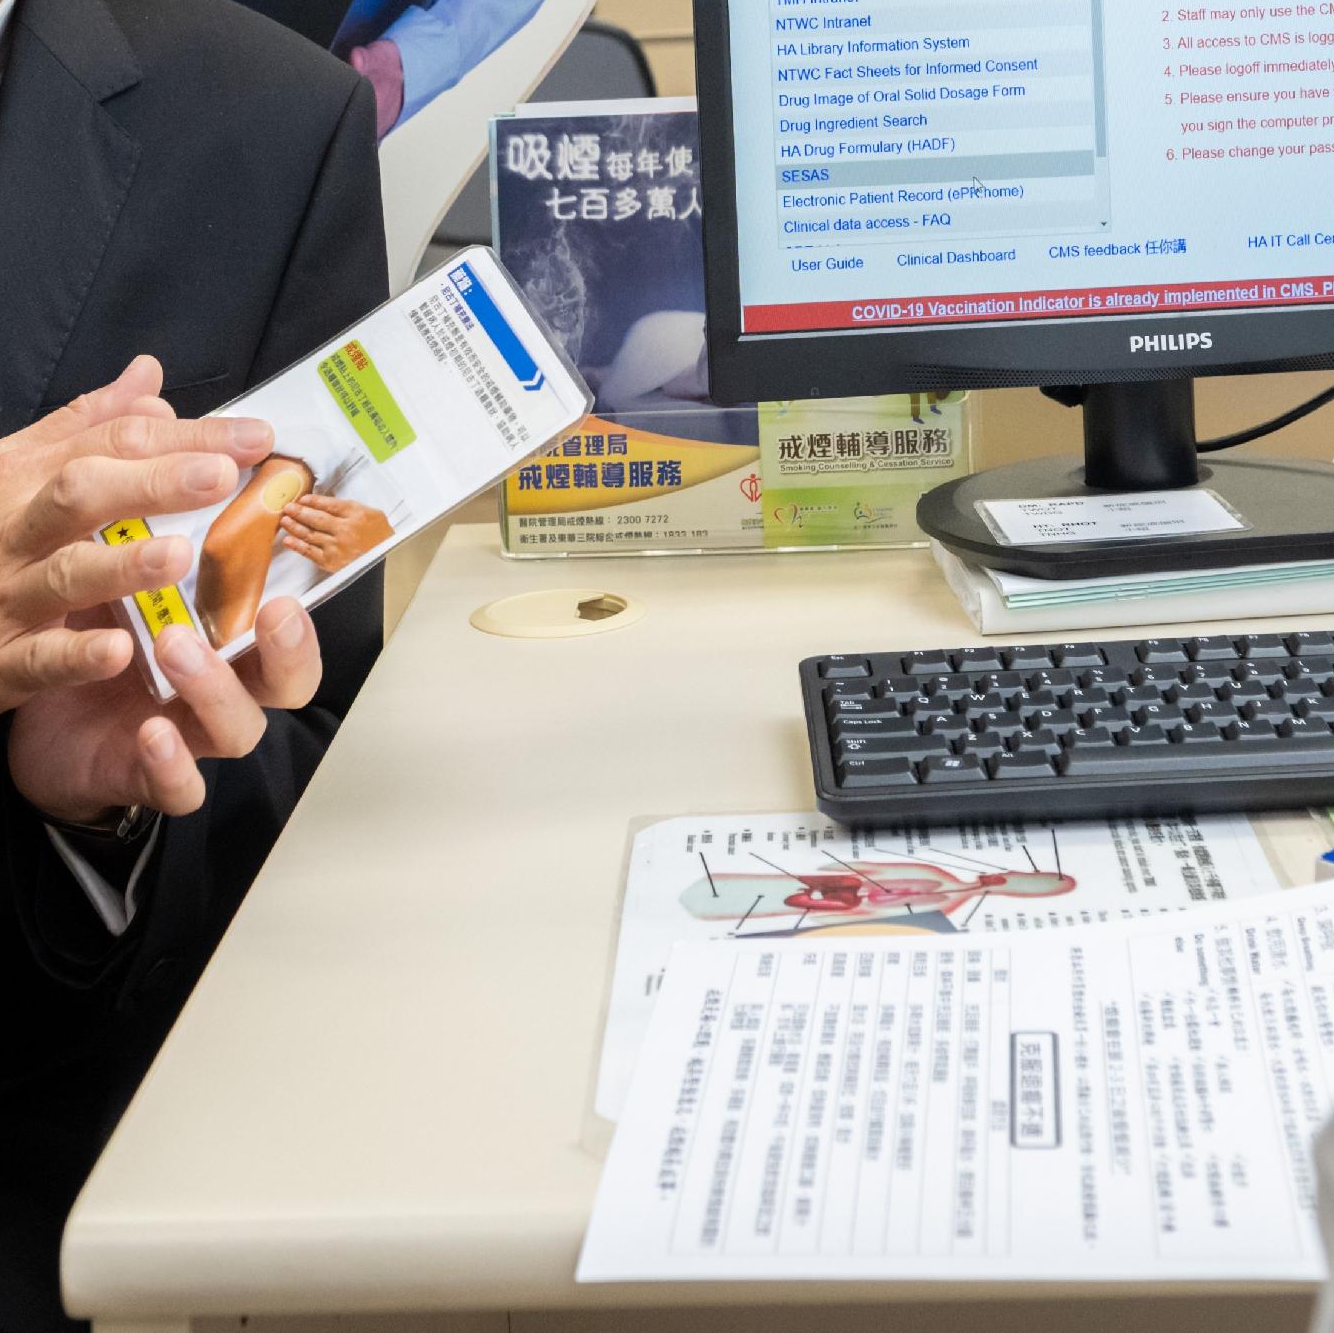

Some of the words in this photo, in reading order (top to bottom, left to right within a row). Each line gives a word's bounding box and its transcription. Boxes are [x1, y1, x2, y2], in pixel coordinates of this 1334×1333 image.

[776, 16, 819, 30] NTWC
[823, 15, 871, 29] Intranet
[777, 43, 797, 56] HA
[800, 40, 843, 57] Library
[847, 38, 919, 54] Information
[923, 36, 970, 53] System
[778, 67, 821, 81] NTWC
[825, 65, 852, 80] Fact
[857, 63, 901, 79] Sheets
[904, 63, 921, 76] for
[926, 60, 981, 75] Informed
[985, 57, 1038, 73] Consent
[1164, 65, 1175, 77] 4.
[1179, 64, 1222, 76] Please
[1226, 61, 1260, 77] logoff
[779, 93, 810, 108] Drug
[814, 91, 853, 107] Image
[857, 90, 870, 103] of
[874, 88, 901, 102] Oral
[904, 87, 936, 101] Solid
[940, 85, 989, 102] Dosage
[993, 83, 1026, 97] Form
[780, 119, 811, 134] Drug
[815, 115, 878, 132] Ingredient
[883, 113, 928, 128] Search
[781, 144, 801, 158] HA
[804, 142, 835, 159] Drug
[839, 139, 902, 157] Formulary
[907, 137, 955, 154] (HADF)
[782, 169, 830, 183] SESAS
[545, 187, 702, 220] 七百多萬人
[783, 194, 846, 208] Electronic
[850, 191, 894, 205] Patient
[898, 188, 943, 203] Record
[984, 184, 1024, 199] home)
[784, 218, 830, 234] Clinical
[834, 217, 861, 231] data
[866, 216, 910, 230] access
[922, 213, 951, 228] FAQ
[1049, 245, 1080, 259] CMS
[1085, 241, 1141, 257] feedback
[1145, 238, 1187, 255] 任你講
[1248, 235, 1267, 248] HA
[1271, 235, 1282, 247] IT
[1287, 233, 1309, 246] Call
[792, 258, 821, 272] User
[826, 256, 864, 270] Guide
[897, 253, 943, 267] Clinical
[947, 248, 1016, 264] Dashboard
[852, 302, 924, 321] COVID-19
[928, 297, 1014, 318] Vaccination
[1019, 294, 1083, 313] Indicator
[1088, 294, 1101, 308] is
[1105, 291, 1159, 310] already
[1165, 285, 1259, 305] implemented
[1263, 284, 1276, 299] in
[1280, 282, 1318, 298] CMS.
[1129, 333, 1213, 353] PHILIPS
[547, 434, 627, 456] 管理局
[778, 428, 948, 460] 戒煙輔導服務
[518, 460, 682, 491] 戒煙輔導服務
[780, 464, 816, 473] Smoking
[818, 461, 868, 471] Counselling
[878, 459, 918, 468] Cessation
[920, 458, 951, 466] Service
[617, 516, 641, 524] 2300
[645, 515, 669, 524] 7272
